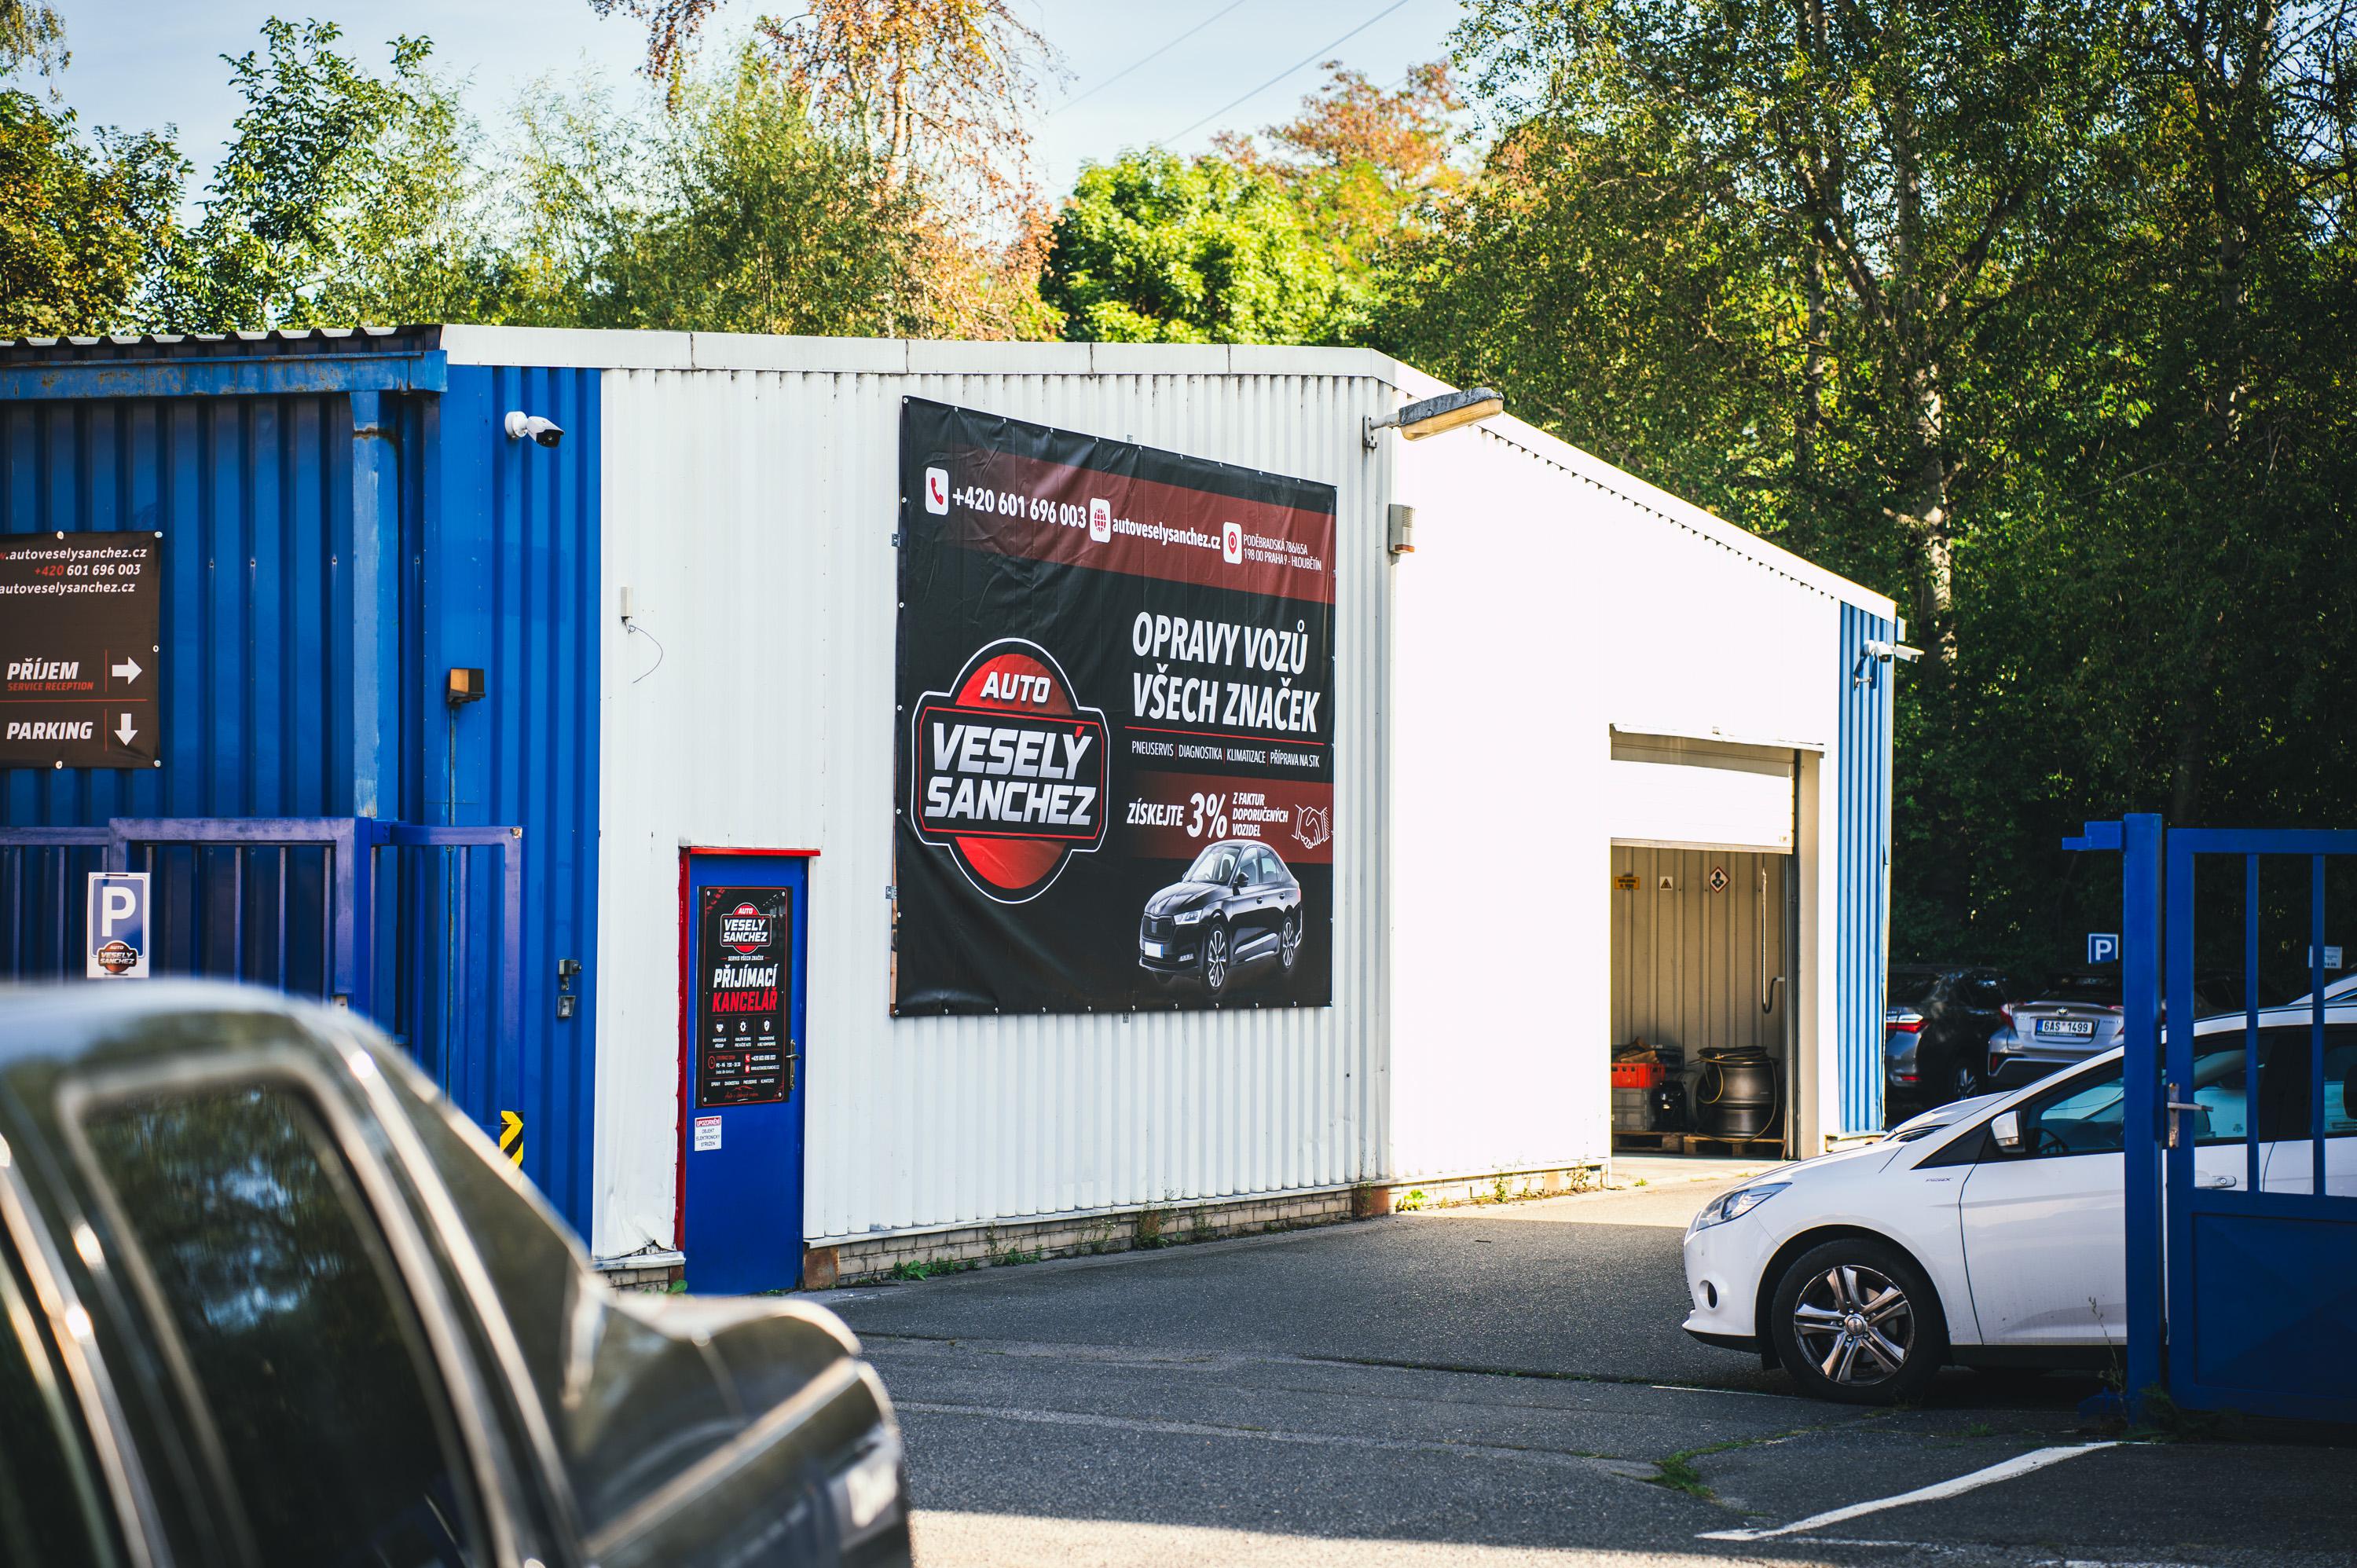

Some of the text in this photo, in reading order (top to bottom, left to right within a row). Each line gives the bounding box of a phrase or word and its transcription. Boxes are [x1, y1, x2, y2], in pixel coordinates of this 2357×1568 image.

[953, 486, 1087, 529] +420 601 696 003
[1113, 518, 1220, 550] autoveselysanchez.cz
[1243, 533, 1285, 551] PODĚBRADSKÁ
[35, 564, 141, 576] +420 601 696 003
[1244, 548, 1255, 560] 198
[1255, 550, 1263, 562] 00
[1264, 551, 1284, 565] PRAHA
[1284, 555, 1288, 565] 9
[1292, 555, 1322, 570] HLOUBĚTÍN
[1132, 611, 1308, 675] OPRAVY VOZŮ
[7, 658, 79, 680] PŘÍJEM
[7, 681, 93, 691] SERVICE RECEPTION
[980, 672, 1050, 703] AUTO
[1134, 663, 1321, 732] VŠECH ZNAČEK
[6, 721, 93, 740] PARKING
[933, 722, 1092, 779] VESELÝ
[1131, 741, 1320, 768] PNEUSERVIS DIAGNOSTIKA KLIMATIZACE PŘÍPRAVA NA STK
[925, 776, 1096, 825] SANCHEZ
[1233, 792, 1265, 806] Z FAKTUR
[1127, 792, 1228, 839] ZÍSKEJTE 3%
[1232, 807, 1288, 823] DOPORUČENÝCH
[1232, 824, 1261, 837] VOZIDEL
[101, 886, 136, 937] P
[724, 918, 765, 931] VESELÝ
[723, 932, 768, 943] SANCHEZ
[2095, 940, 2112, 961] P
[713, 963, 778, 988] PŘIJÍMACÍ
[712, 987, 778, 1012] KANCELÁŘ
[2044, 1021, 2088, 1032] 6AS 1499
